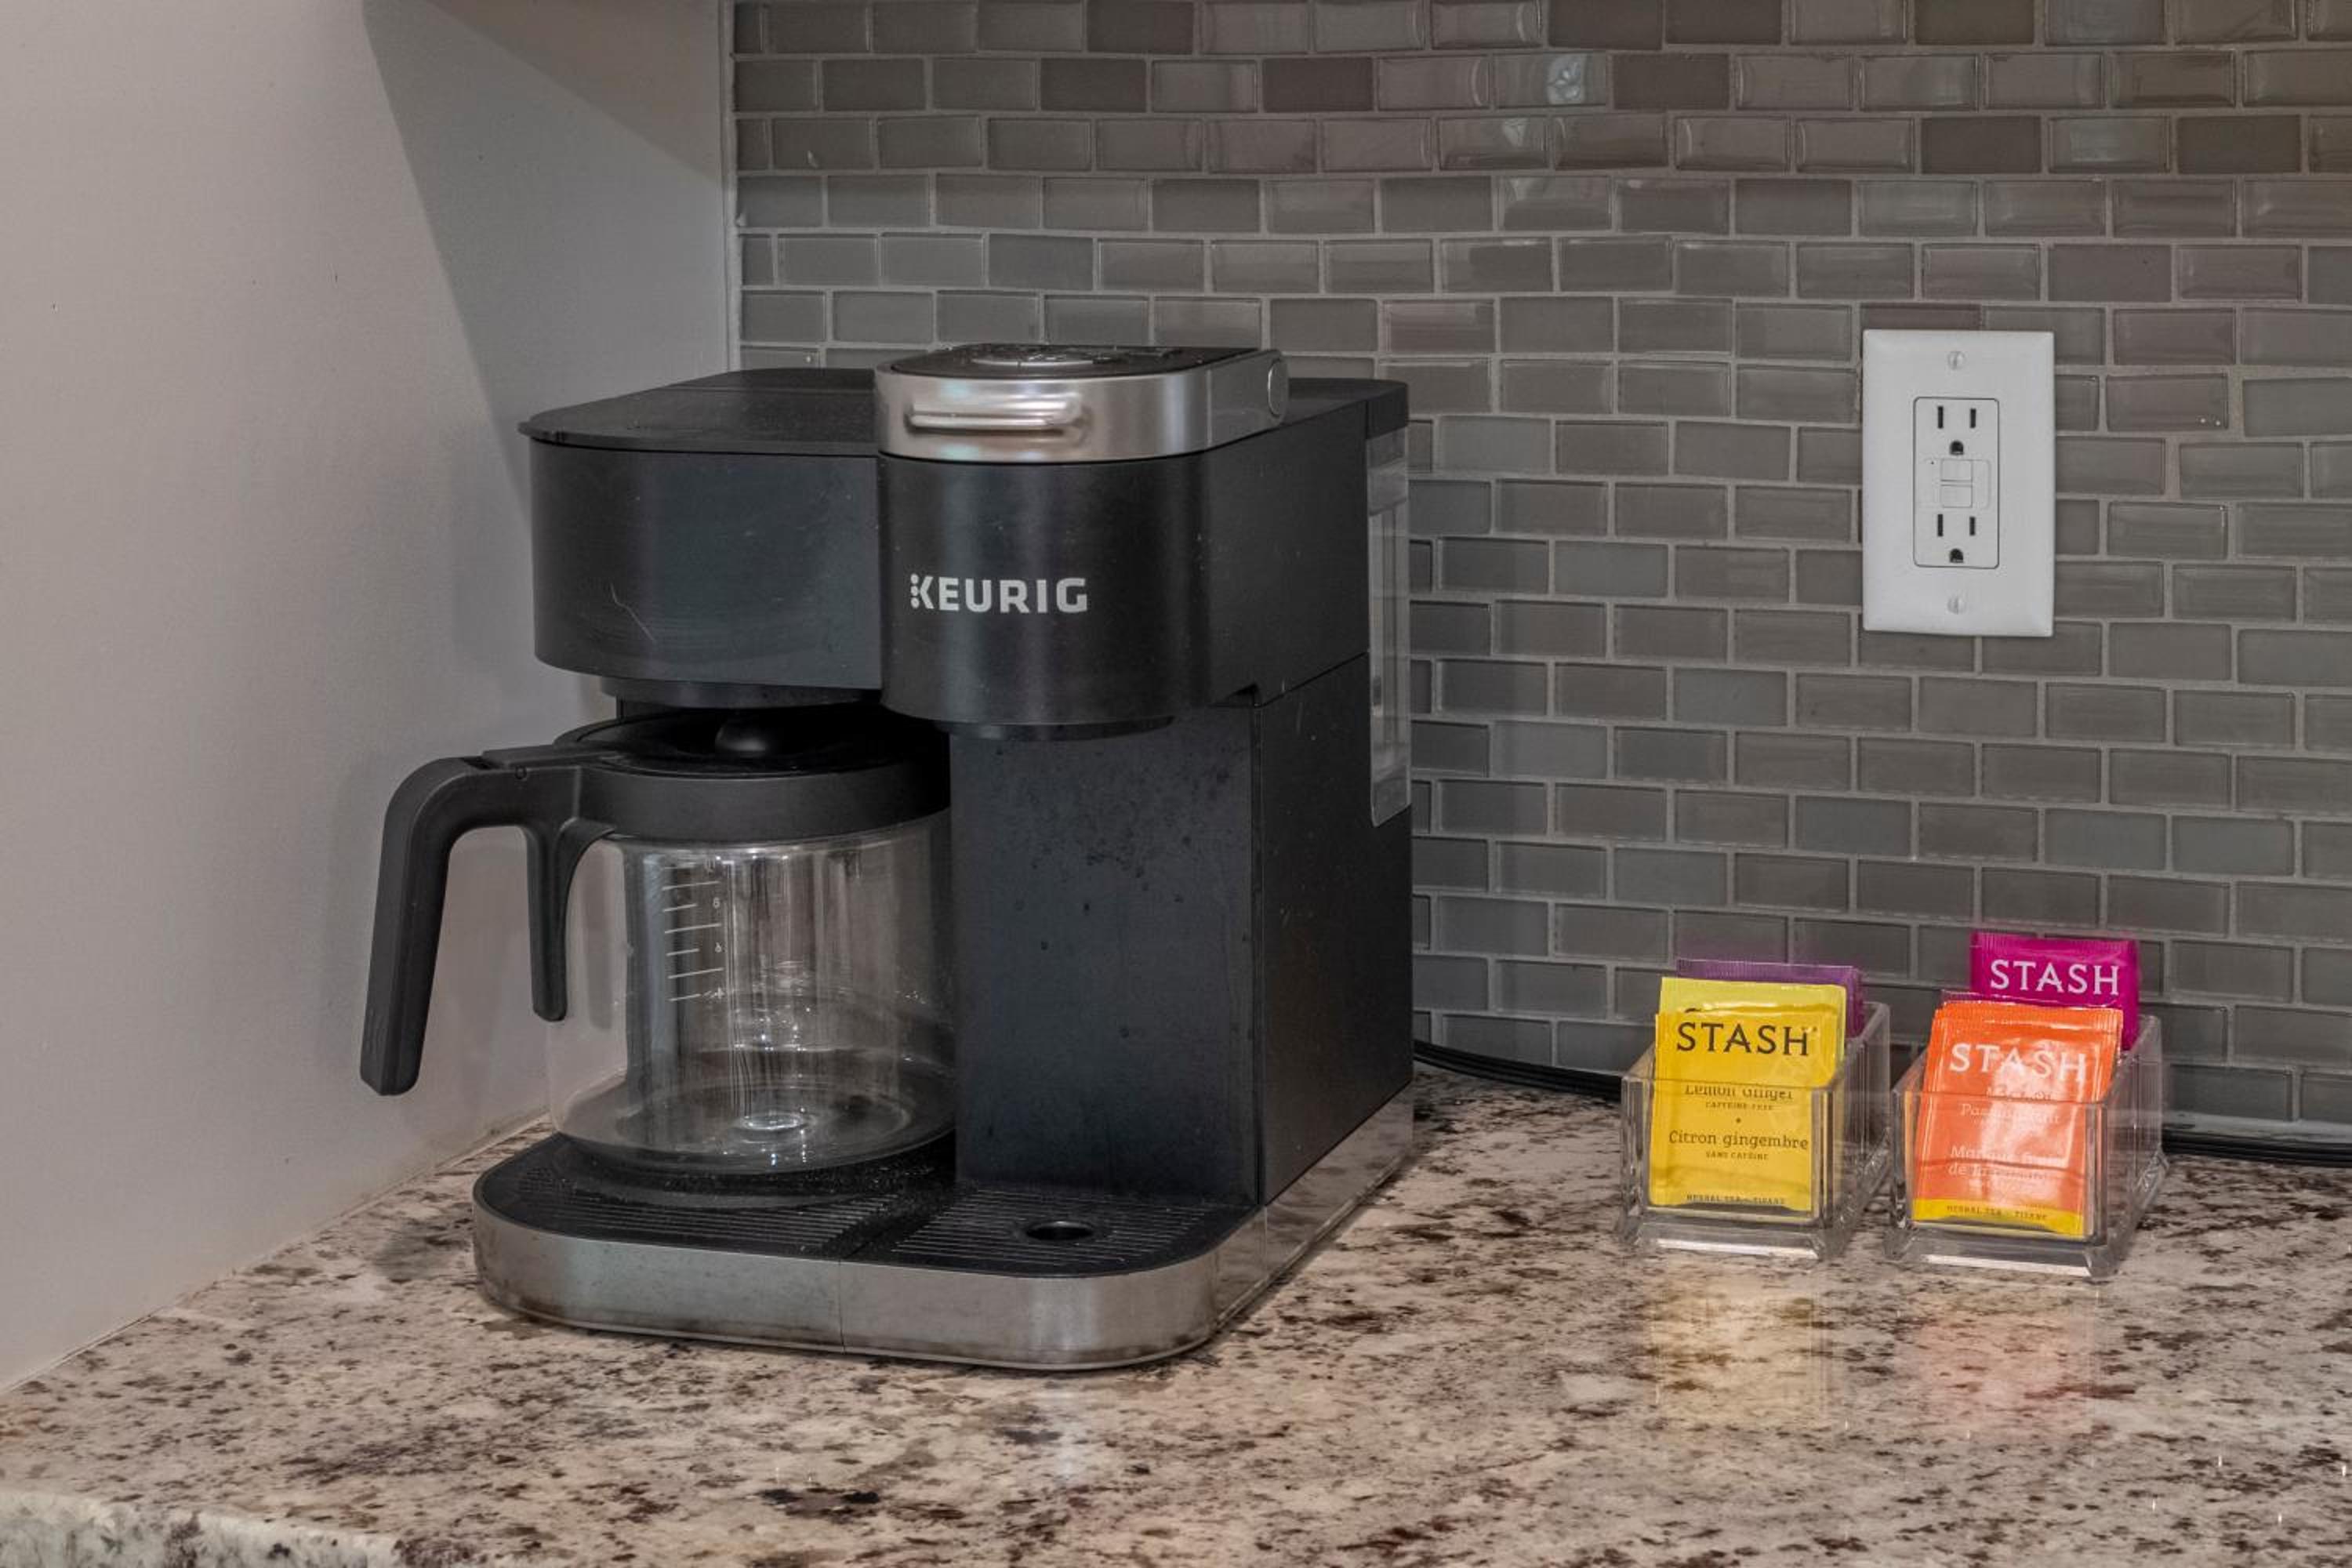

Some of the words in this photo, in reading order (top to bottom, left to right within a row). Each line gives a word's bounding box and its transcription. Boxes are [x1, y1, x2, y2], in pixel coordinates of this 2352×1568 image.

[910, 573, 1087, 613] KEURIG
[1990, 959, 2119, 996] STASH
[1676, 1022, 1809, 1056] STASH
[1949, 1042, 2086, 1083] STASH
[1669, 1130, 1716, 1145] Citron
[1722, 1131, 1809, 1150] gingembre
